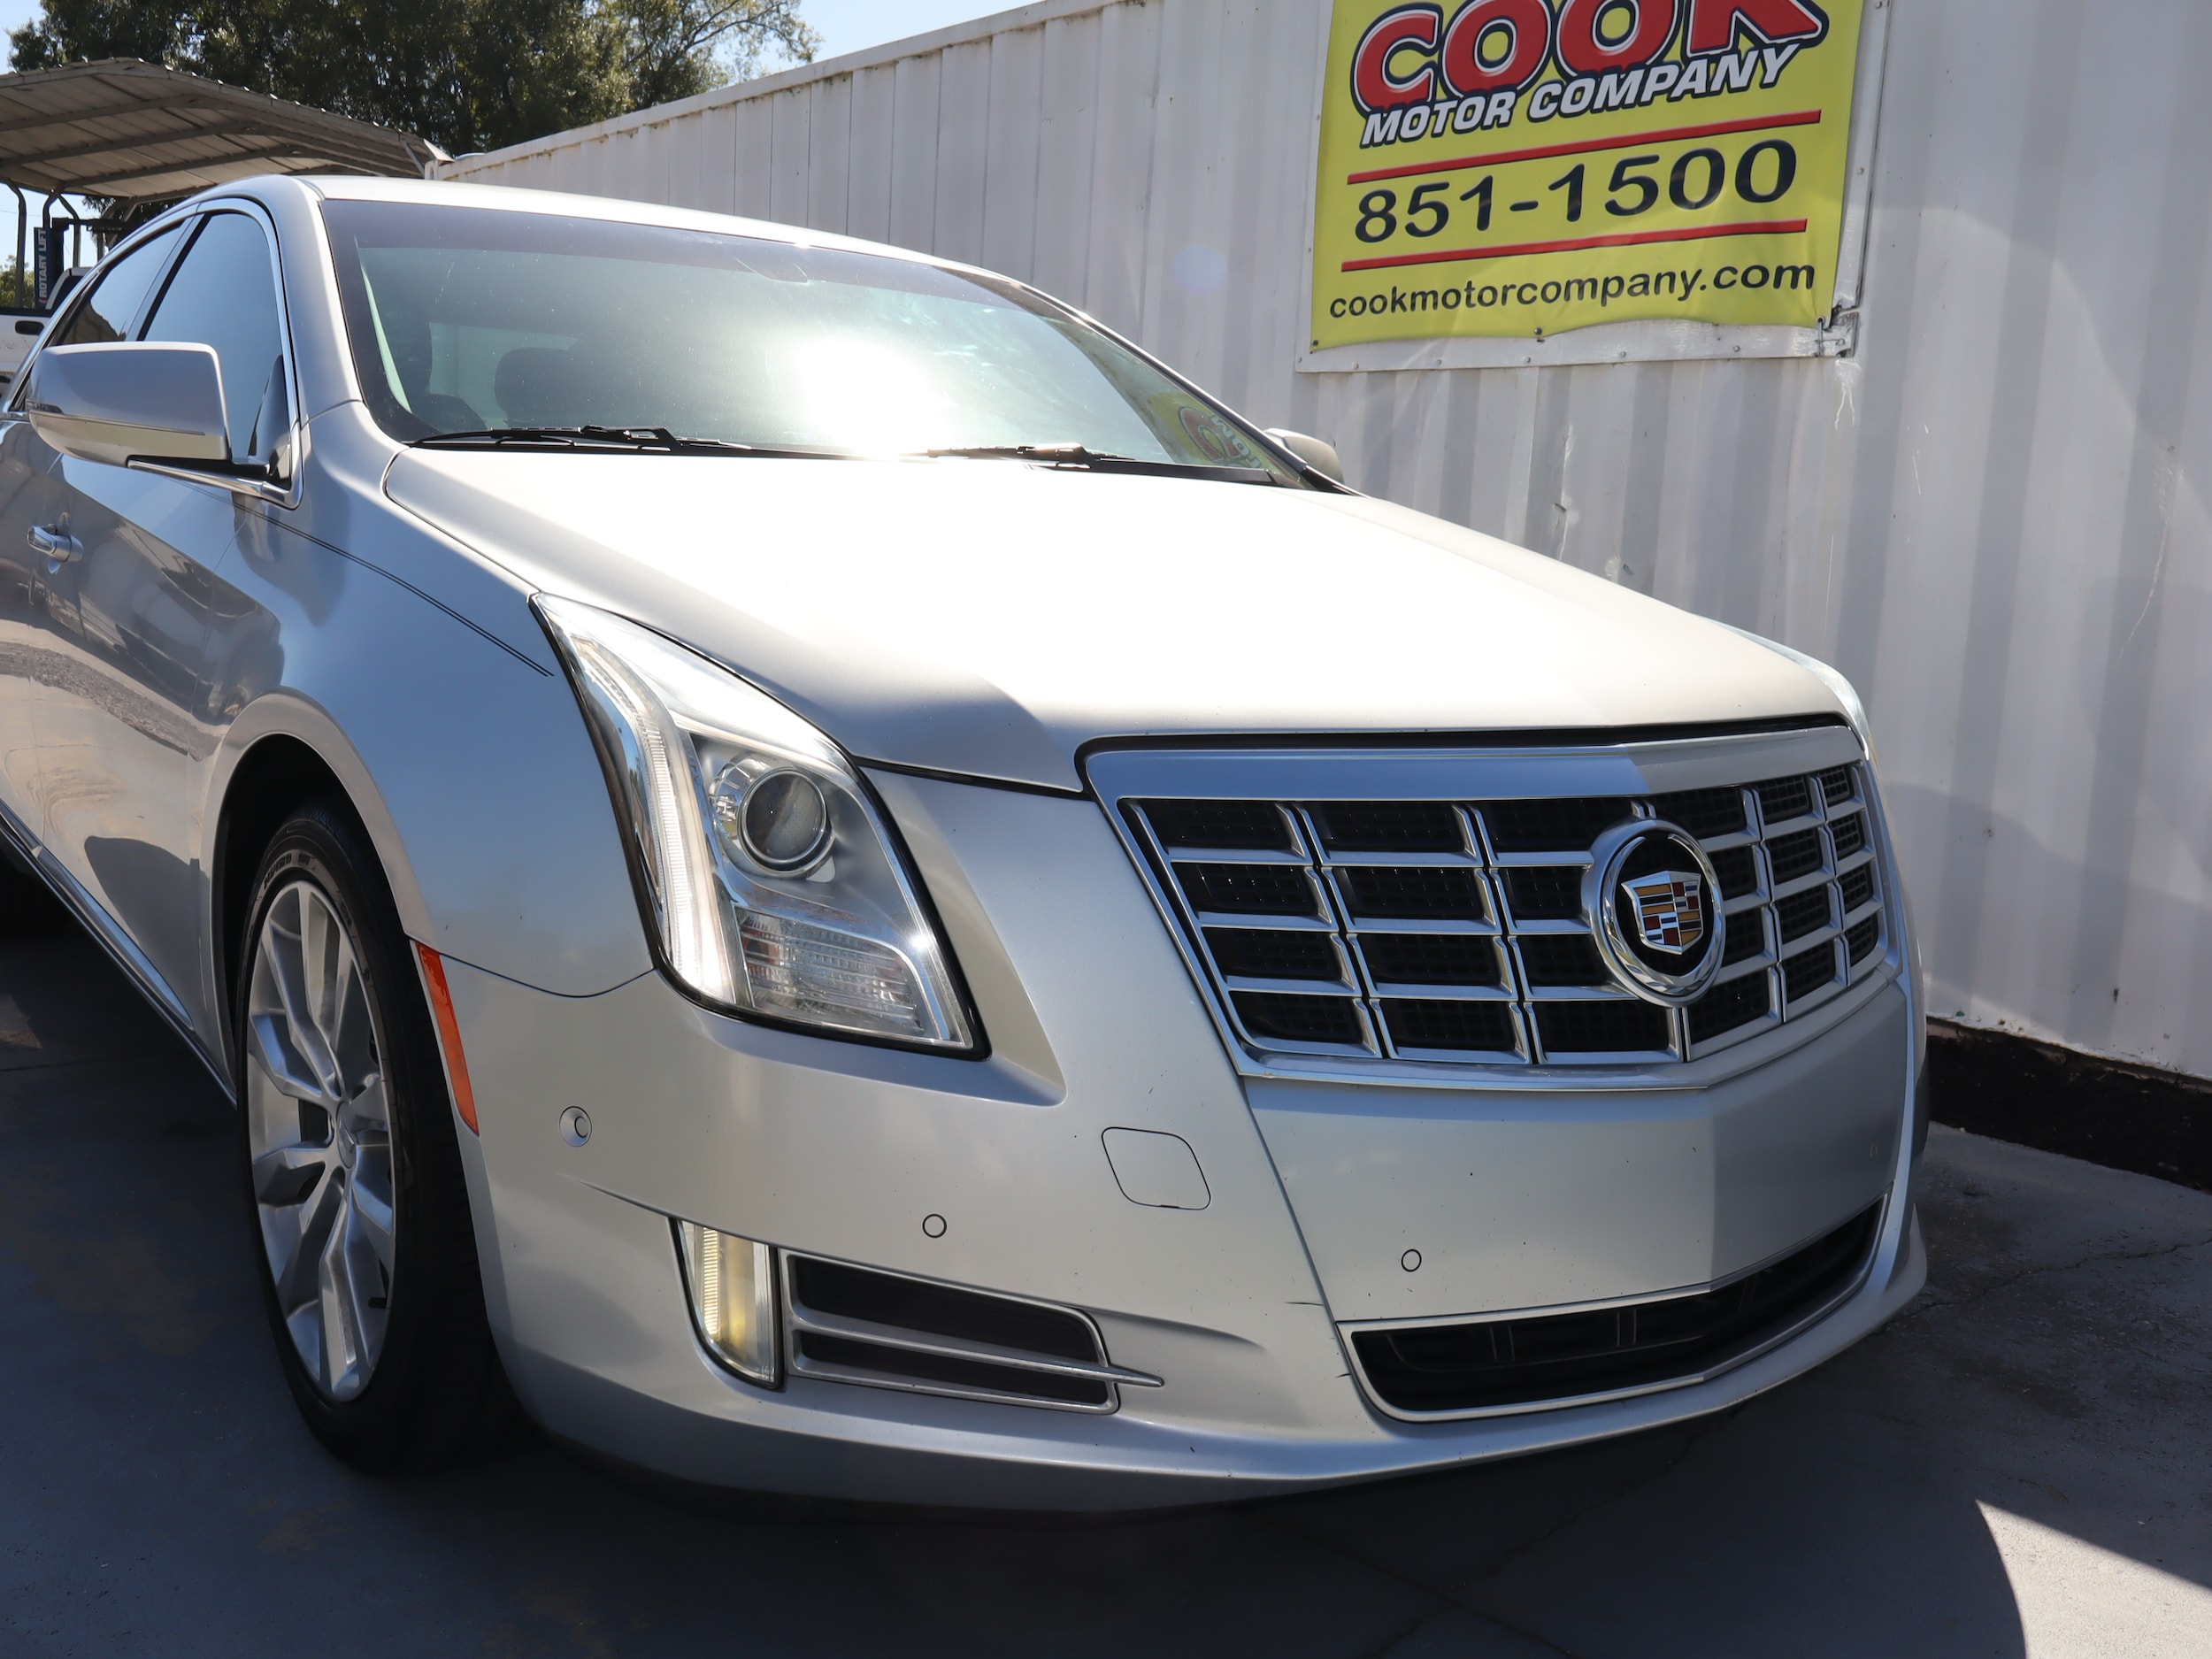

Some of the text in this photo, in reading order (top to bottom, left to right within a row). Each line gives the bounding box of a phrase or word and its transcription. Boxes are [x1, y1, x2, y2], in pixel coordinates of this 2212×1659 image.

[1362, 43, 1800, 146] MOTOR COMPANY
[1355, 139, 1797, 243] 851-1500
[38, 229, 47, 298] ROTARY LIFT
[1330, 265, 1816, 319] cookmotorcompany.com
